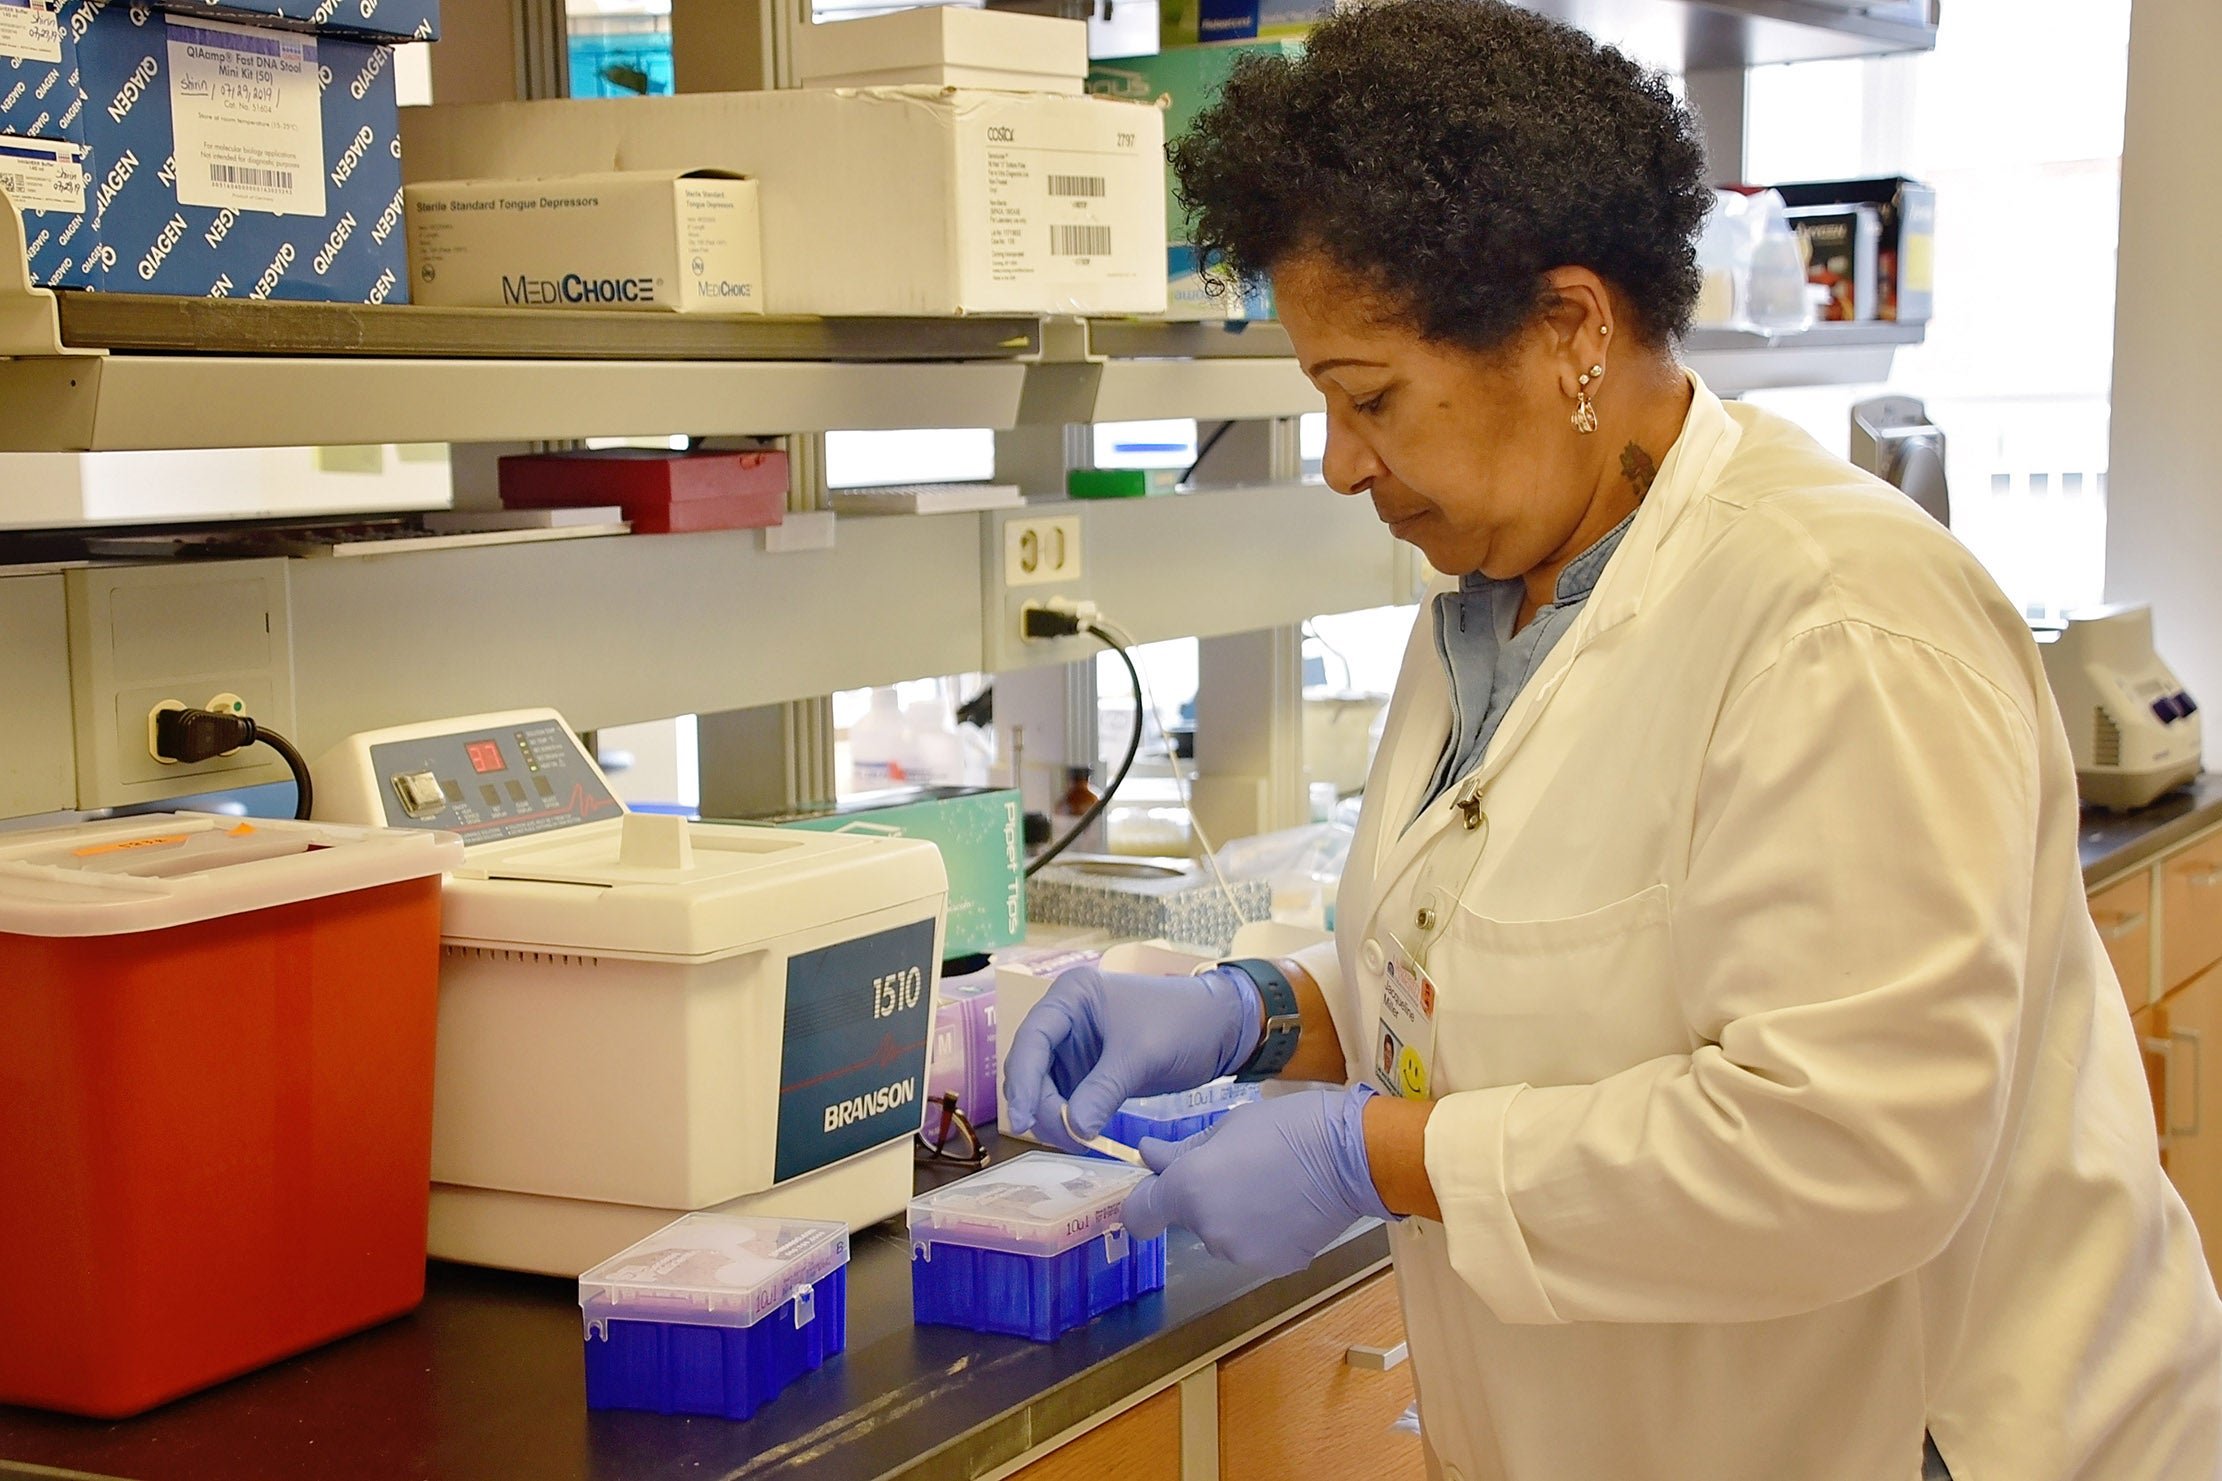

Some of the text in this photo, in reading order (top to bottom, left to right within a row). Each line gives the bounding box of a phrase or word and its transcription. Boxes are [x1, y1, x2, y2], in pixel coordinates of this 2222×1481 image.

[219, 65, 274, 85] Mini Kit (50)
[236, 54, 254, 66] Fast
[257, 56, 278, 69] DNA
[280, 60, 302, 73] Stool
[350, 45, 394, 100] QIAGEN
[0, 81, 26, 113] QIAGEN
[35, 68, 60, 100] QIAGEN
[107, 56, 158, 124] QIAGEN
[26, 111, 50, 137] QIAGE
[59, 98, 83, 129] QIAGEN
[331, 125, 374, 188] QIAGEN
[416, 196, 599, 212] Sterile Standard Tongue Depressors
[59, 214, 84, 246] QIAGEN
[313, 211, 357, 275] QIAGEN
[138, 213, 188, 280] QIAGEN
[364, 267, 397, 304] GEN
[468, 745, 503, 773] 37
[873, 966, 921, 1019] 1510
[824, 1077, 915, 1133] BRANSON
